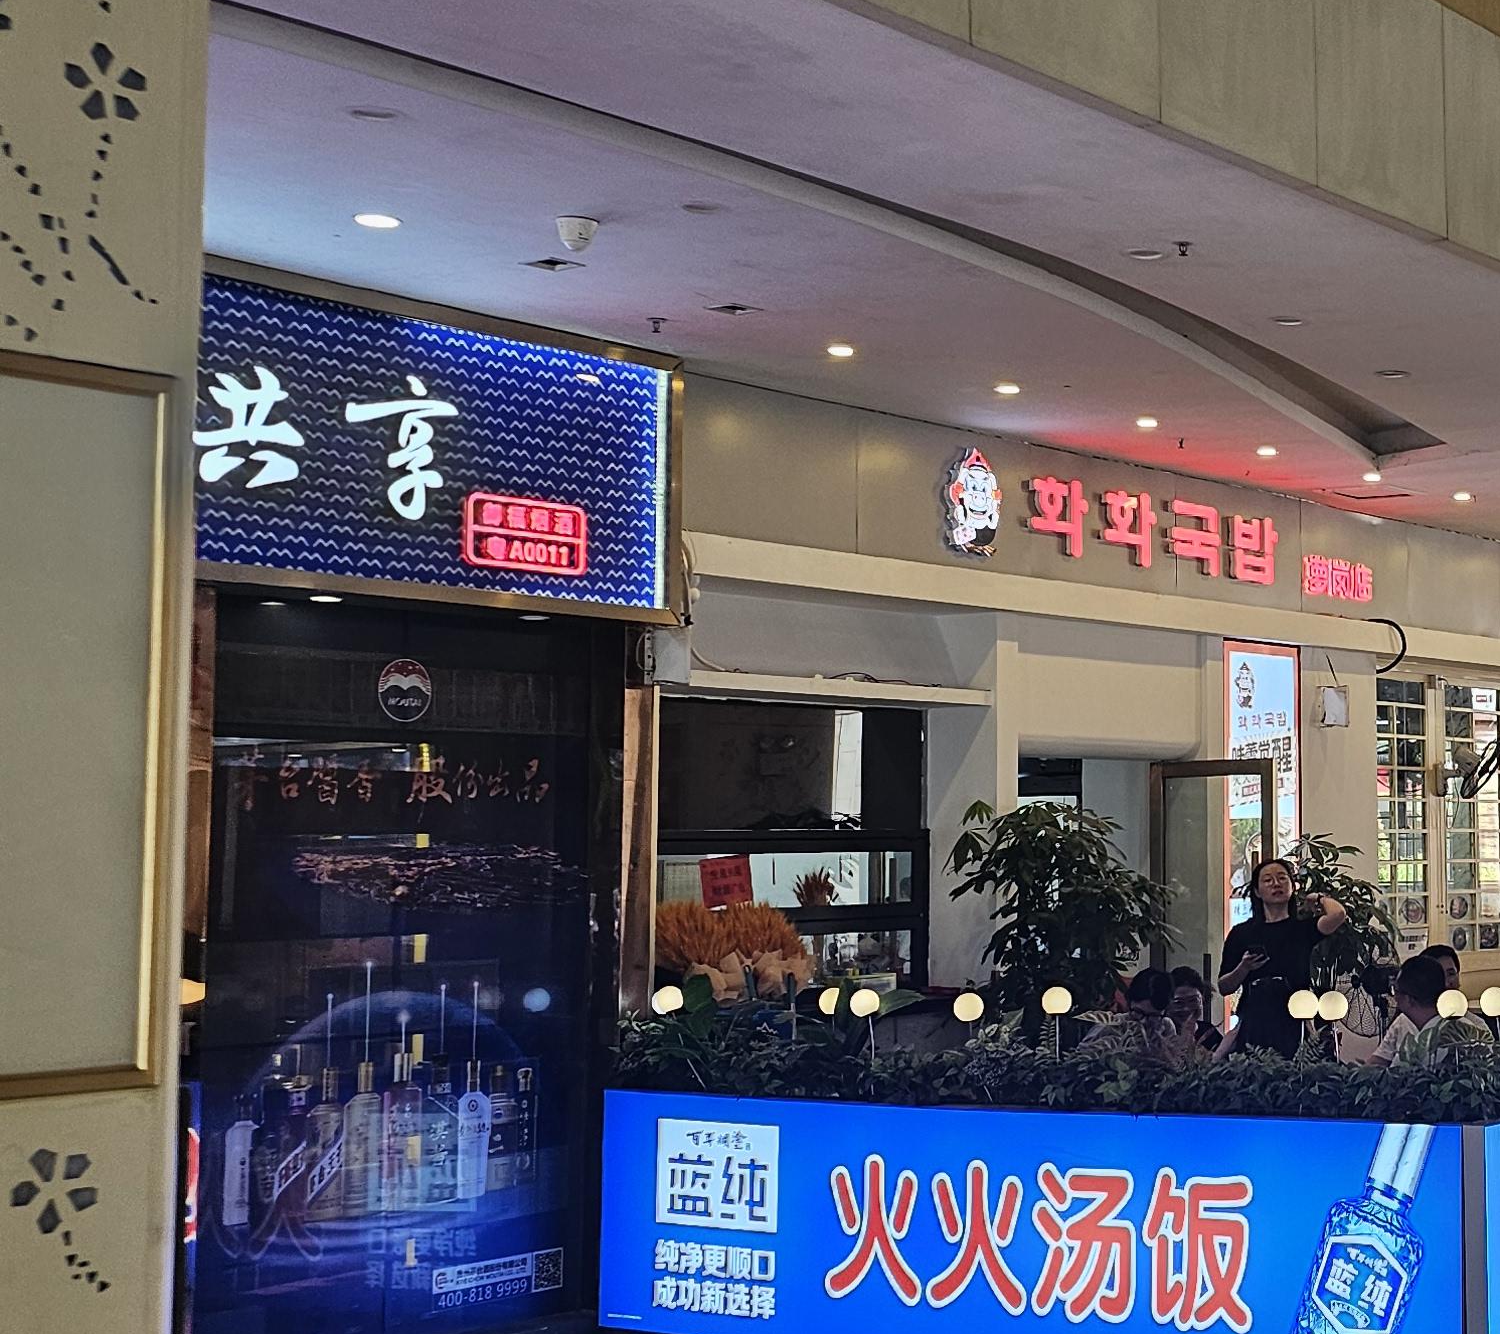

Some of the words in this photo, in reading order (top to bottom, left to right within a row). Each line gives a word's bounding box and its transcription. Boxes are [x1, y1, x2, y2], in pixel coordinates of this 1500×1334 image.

[193, 366, 459, 521] 共享
[1028, 474, 1280, 586] 화화국밥
[666, 1153, 769, 1223] 蓝纯
[654, 1238, 776, 1283] 纯净更顺口
[825, 1153, 1254, 1334] 火火汤饭
[438, 1285, 493, 1309] 400-818
[496, 1278, 528, 1298] 9999
[652, 1275, 776, 1320] 成功新选择
